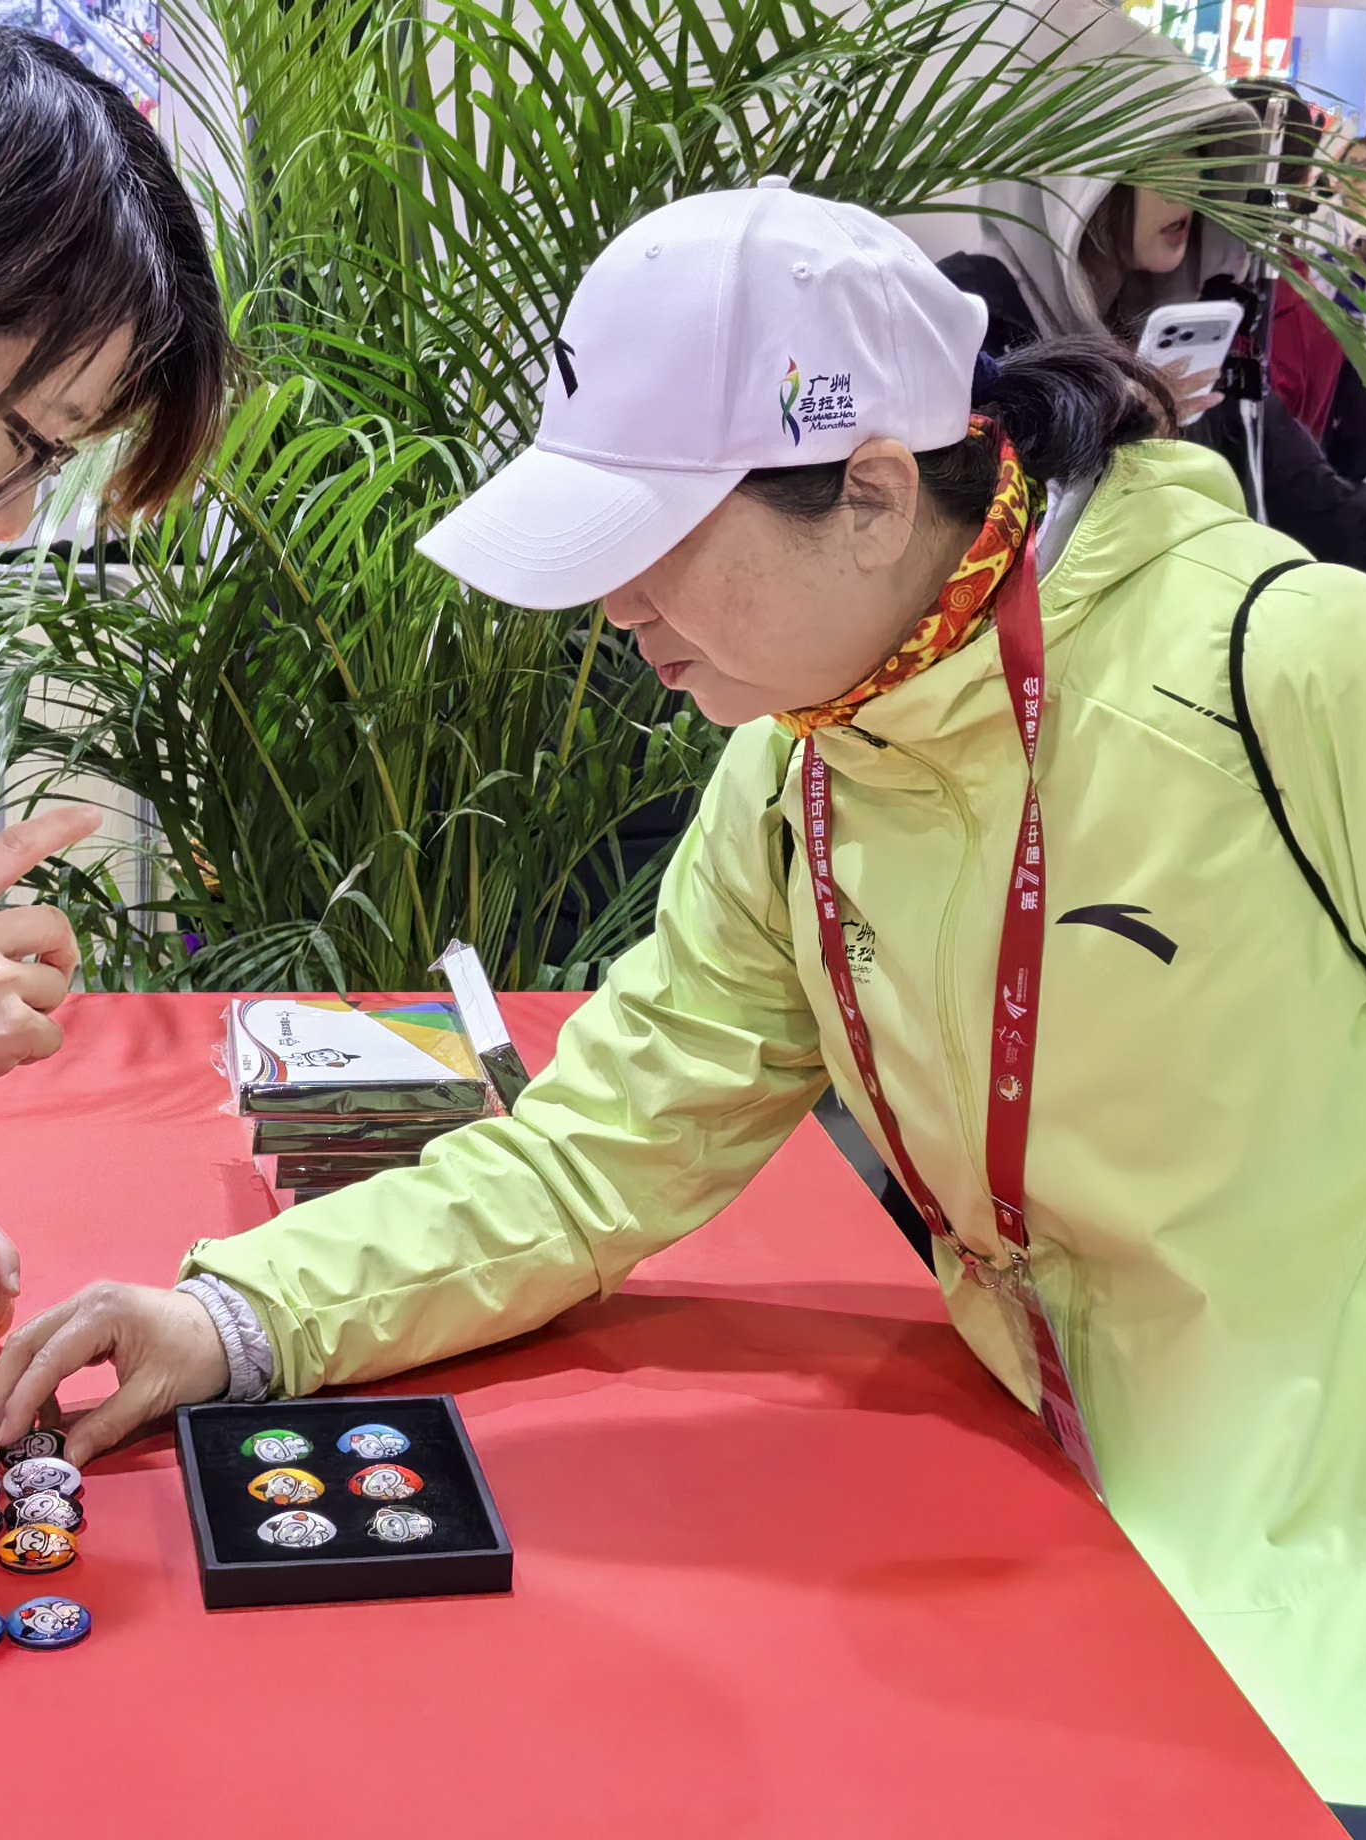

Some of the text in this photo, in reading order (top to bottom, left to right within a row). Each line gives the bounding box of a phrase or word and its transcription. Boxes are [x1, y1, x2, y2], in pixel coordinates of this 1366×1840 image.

[808, 373, 851, 396] 广州
[798, 395, 854, 413] 马拉松
[808, 420, 856, 432] Marathon
[809, 746, 836, 920] 第7届中国马拉松
[844, 944, 876, 963] 拉松
